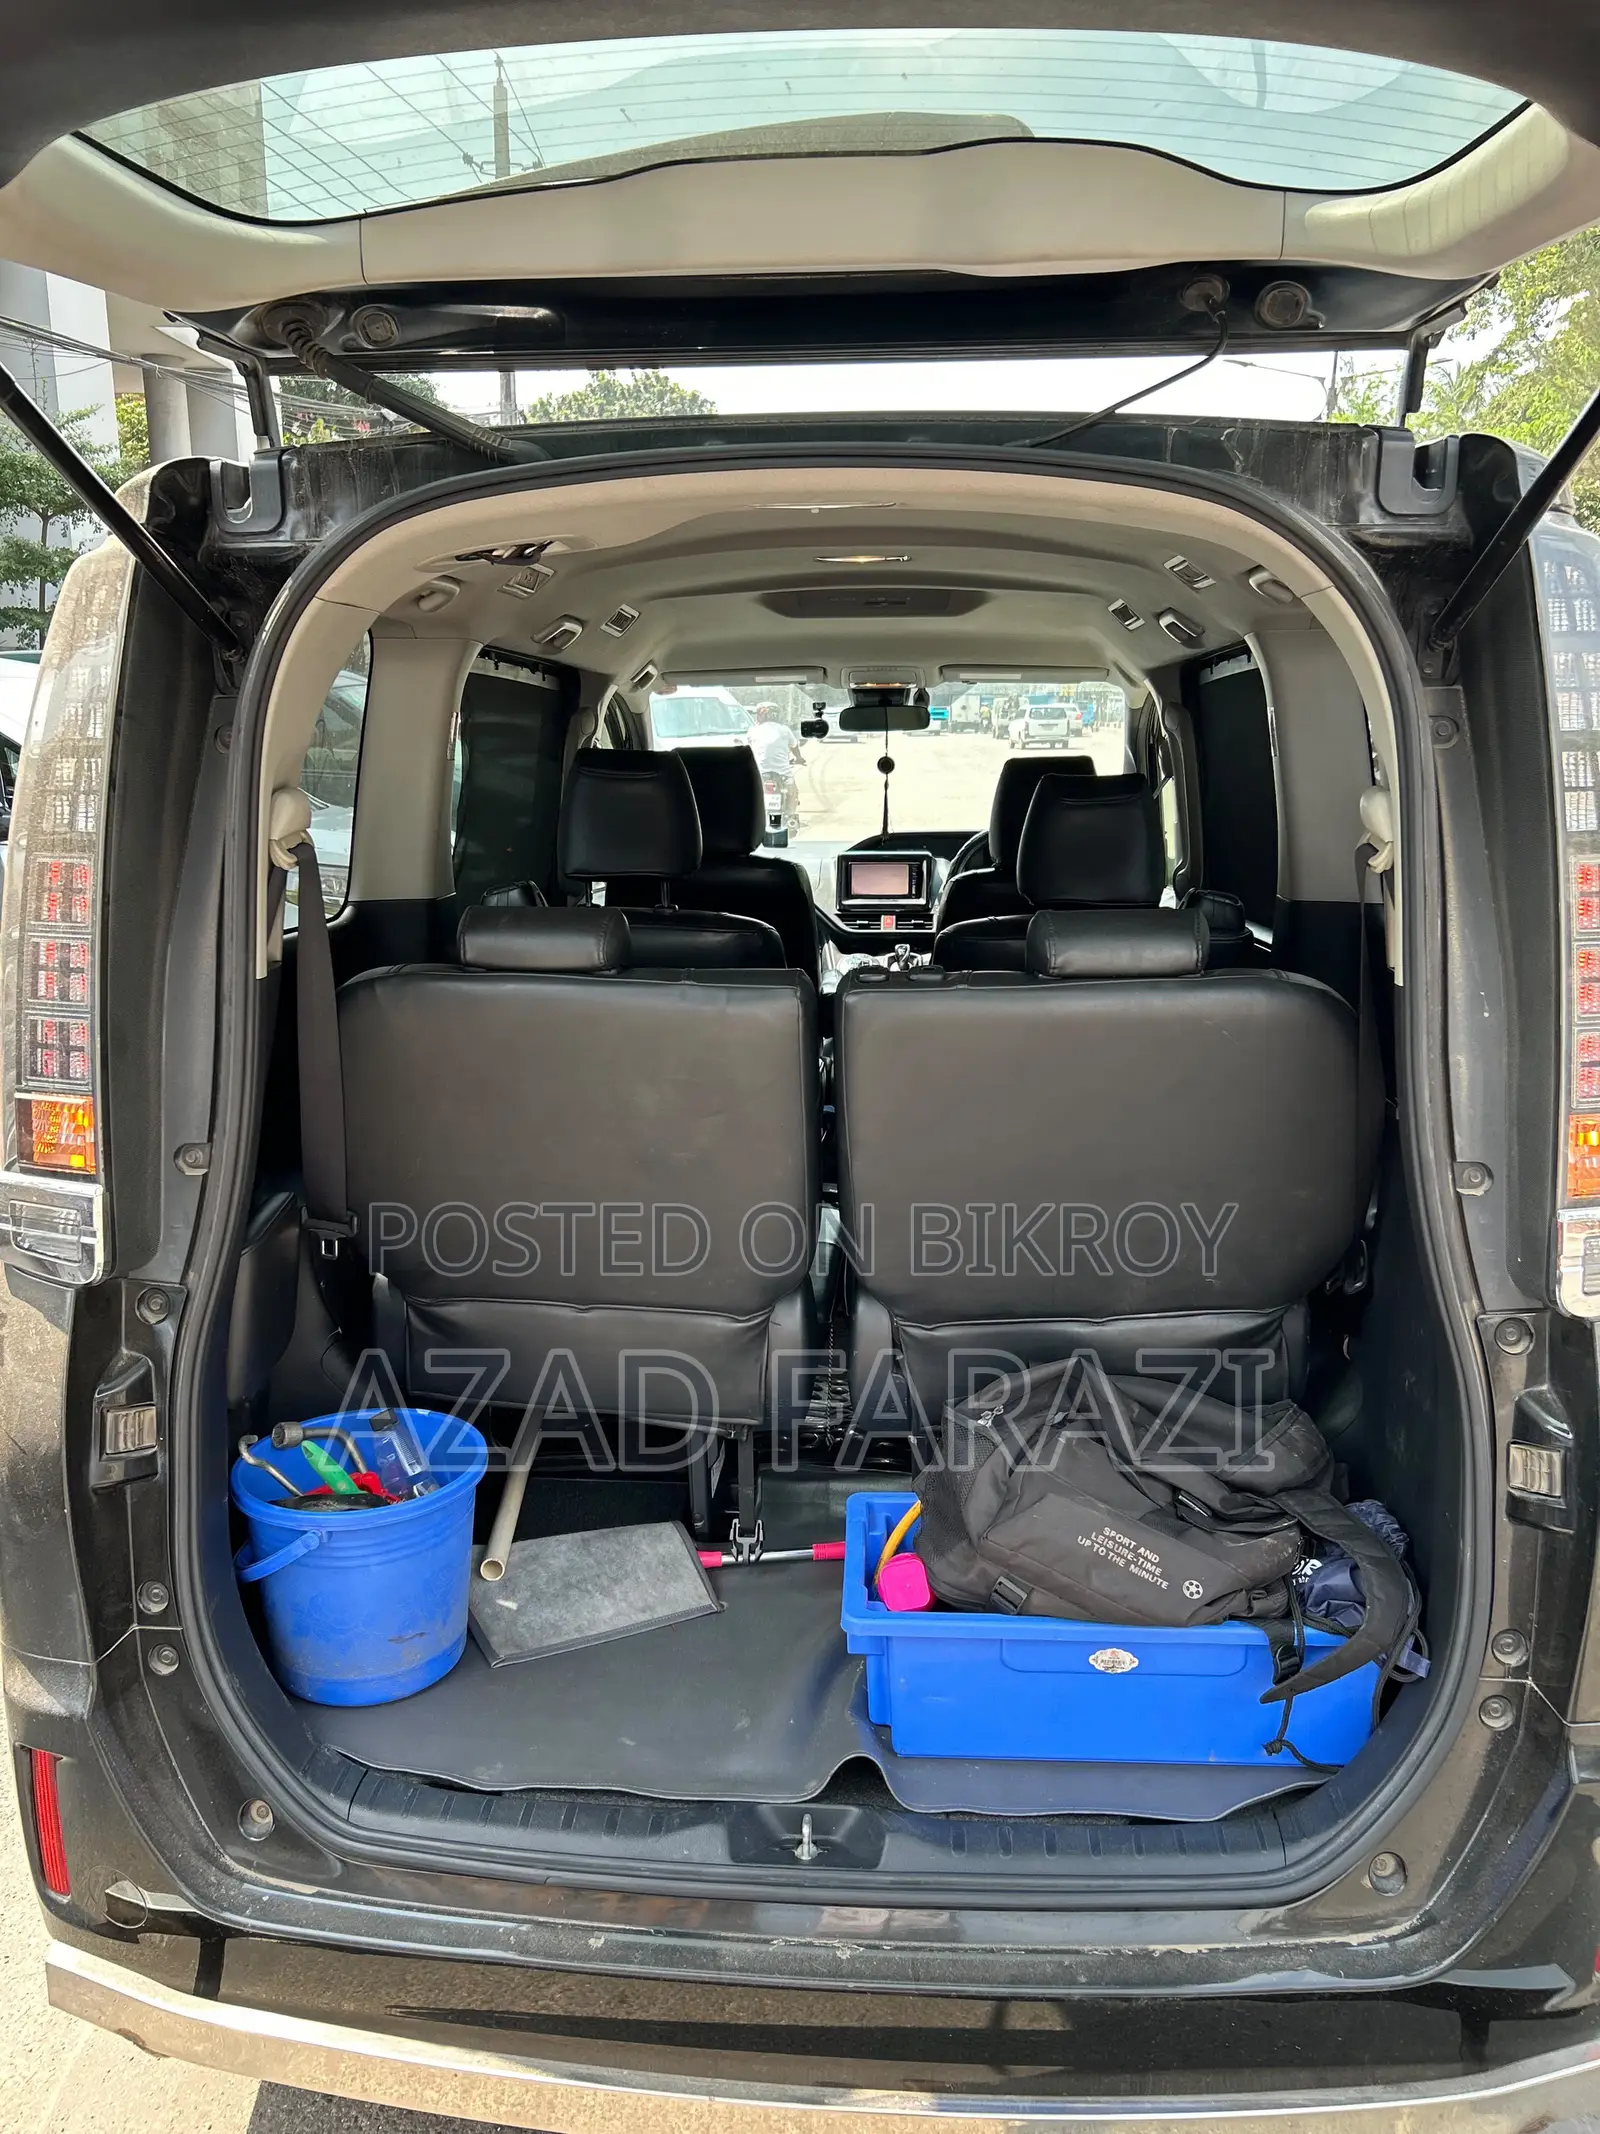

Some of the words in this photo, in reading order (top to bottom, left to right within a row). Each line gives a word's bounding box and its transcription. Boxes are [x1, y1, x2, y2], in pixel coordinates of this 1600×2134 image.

[1077, 1535, 1092, 1547] UP
[1092, 1542, 1107, 1556] TO
[1107, 1551, 1127, 1568] THE
[1128, 1563, 1169, 1590] MINUTE
[1090, 1531, 1163, 1576] LEISURE-TIME
[1102, 1526, 1137, 1549] SPORT
[1137, 1546, 1160, 1563] AND
